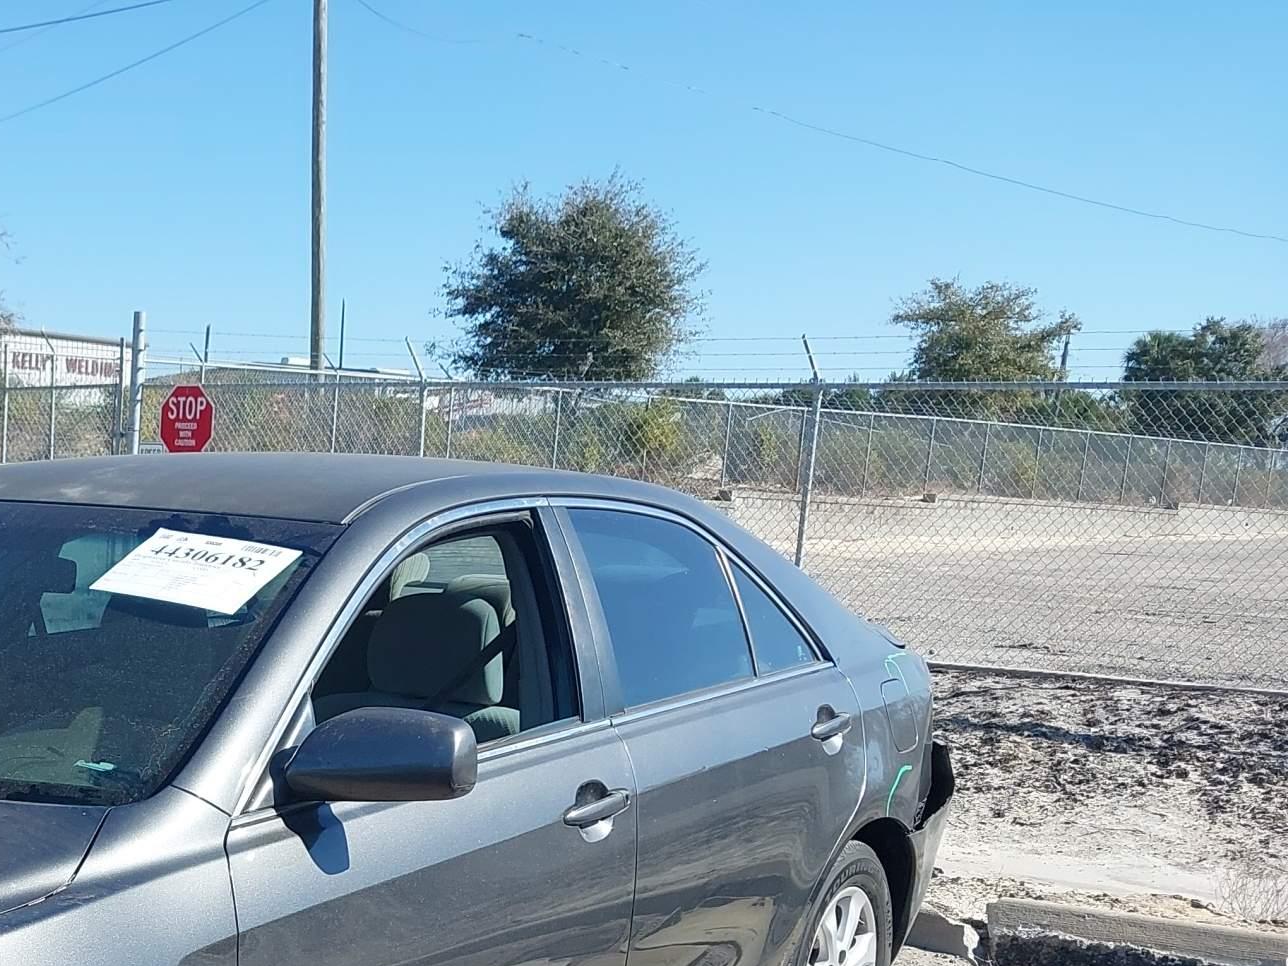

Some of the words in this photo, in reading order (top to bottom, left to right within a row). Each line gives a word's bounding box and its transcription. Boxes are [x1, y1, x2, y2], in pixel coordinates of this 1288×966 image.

[168, 396, 207, 420] STOP
[174, 422, 198, 430] PROCEED
[151, 544, 266, 571] 44306182
